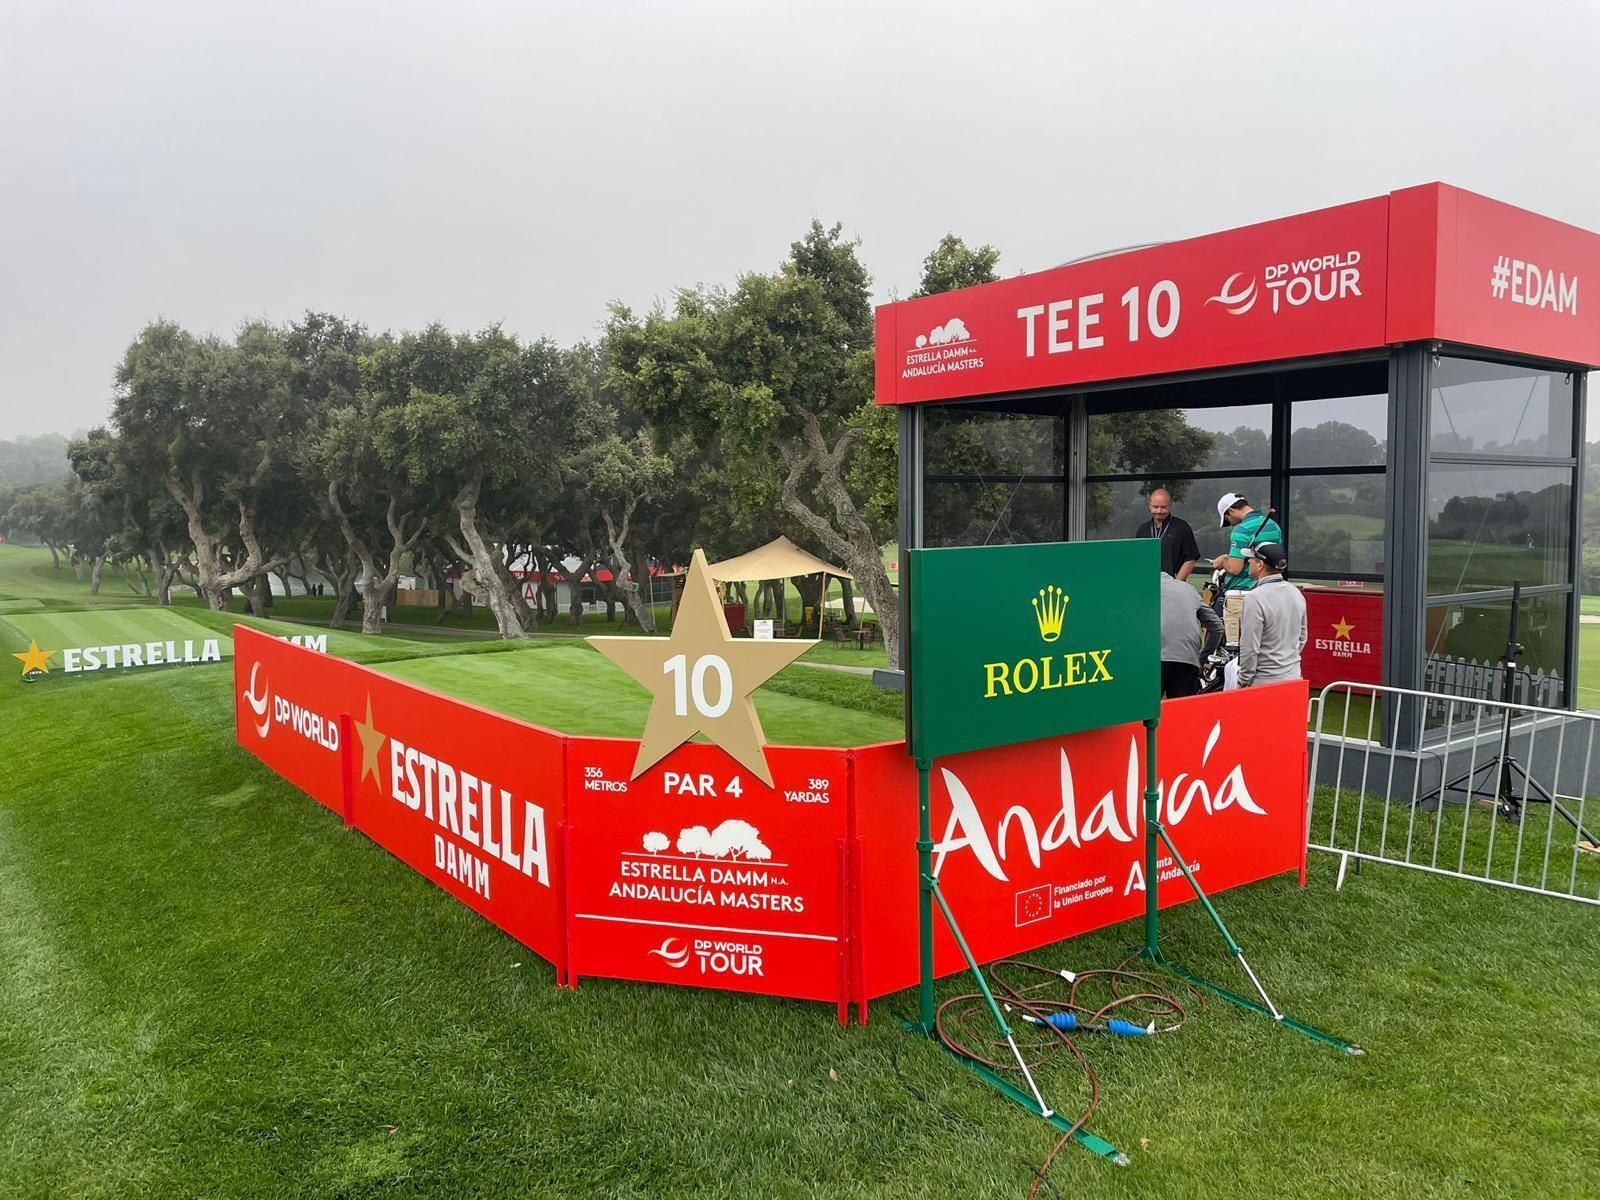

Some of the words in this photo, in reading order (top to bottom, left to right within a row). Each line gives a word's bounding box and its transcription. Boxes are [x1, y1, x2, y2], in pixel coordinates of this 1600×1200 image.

[1265, 263, 1289, 280] DP
[1291, 250, 1361, 275] WORLD
[1265, 268, 1362, 314] TOUR
[1490, 255, 1578, 316] #EDAM
[1017, 293, 1104, 357] TEE
[1121, 279, 1181, 342] 10
[902, 361, 946, 379] ANDALUCÍA
[947, 357, 984, 372] MASTERS
[906, 350, 942, 365] ESTRELLA
[943, 346, 969, 359] DAMM
[63, 639, 221, 673] ESTRELLA
[1315, 638, 1371, 654] ESTRELLA
[663, 654, 733, 718] 10
[984, 649, 1113, 698] ROLEX
[274, 694, 290, 725] DP
[290, 704, 339, 752] WORLD
[584, 767, 603, 778] 356
[663, 771, 717, 797] PAR
[725, 775, 743, 798] 4
[808, 779, 829, 790] 389
[584, 780, 628, 793] METROS
[784, 790, 829, 804] YARDAS
[390, 737, 550, 888] ESTRELLA
[434, 833, 490, 901] DAMM
[621, 860, 706, 883] ESTRELLA
[710, 868, 768, 887] DAMM
[770, 877, 789, 886] N.A.
[609, 882, 716, 906] ANDALUCÍA
[720, 892, 804, 913] MASTERS
[1054, 879, 1093, 896] Financiado
[1094, 875, 1106, 887] por
[1054, 899, 1061, 909] la
[1062, 892, 1084, 907] Unión
[1085, 885, 1114, 901] Europea
[694, 939, 713, 950] DP
[713, 941, 763, 955] WORLD
[695, 950, 764, 976] TOUR
